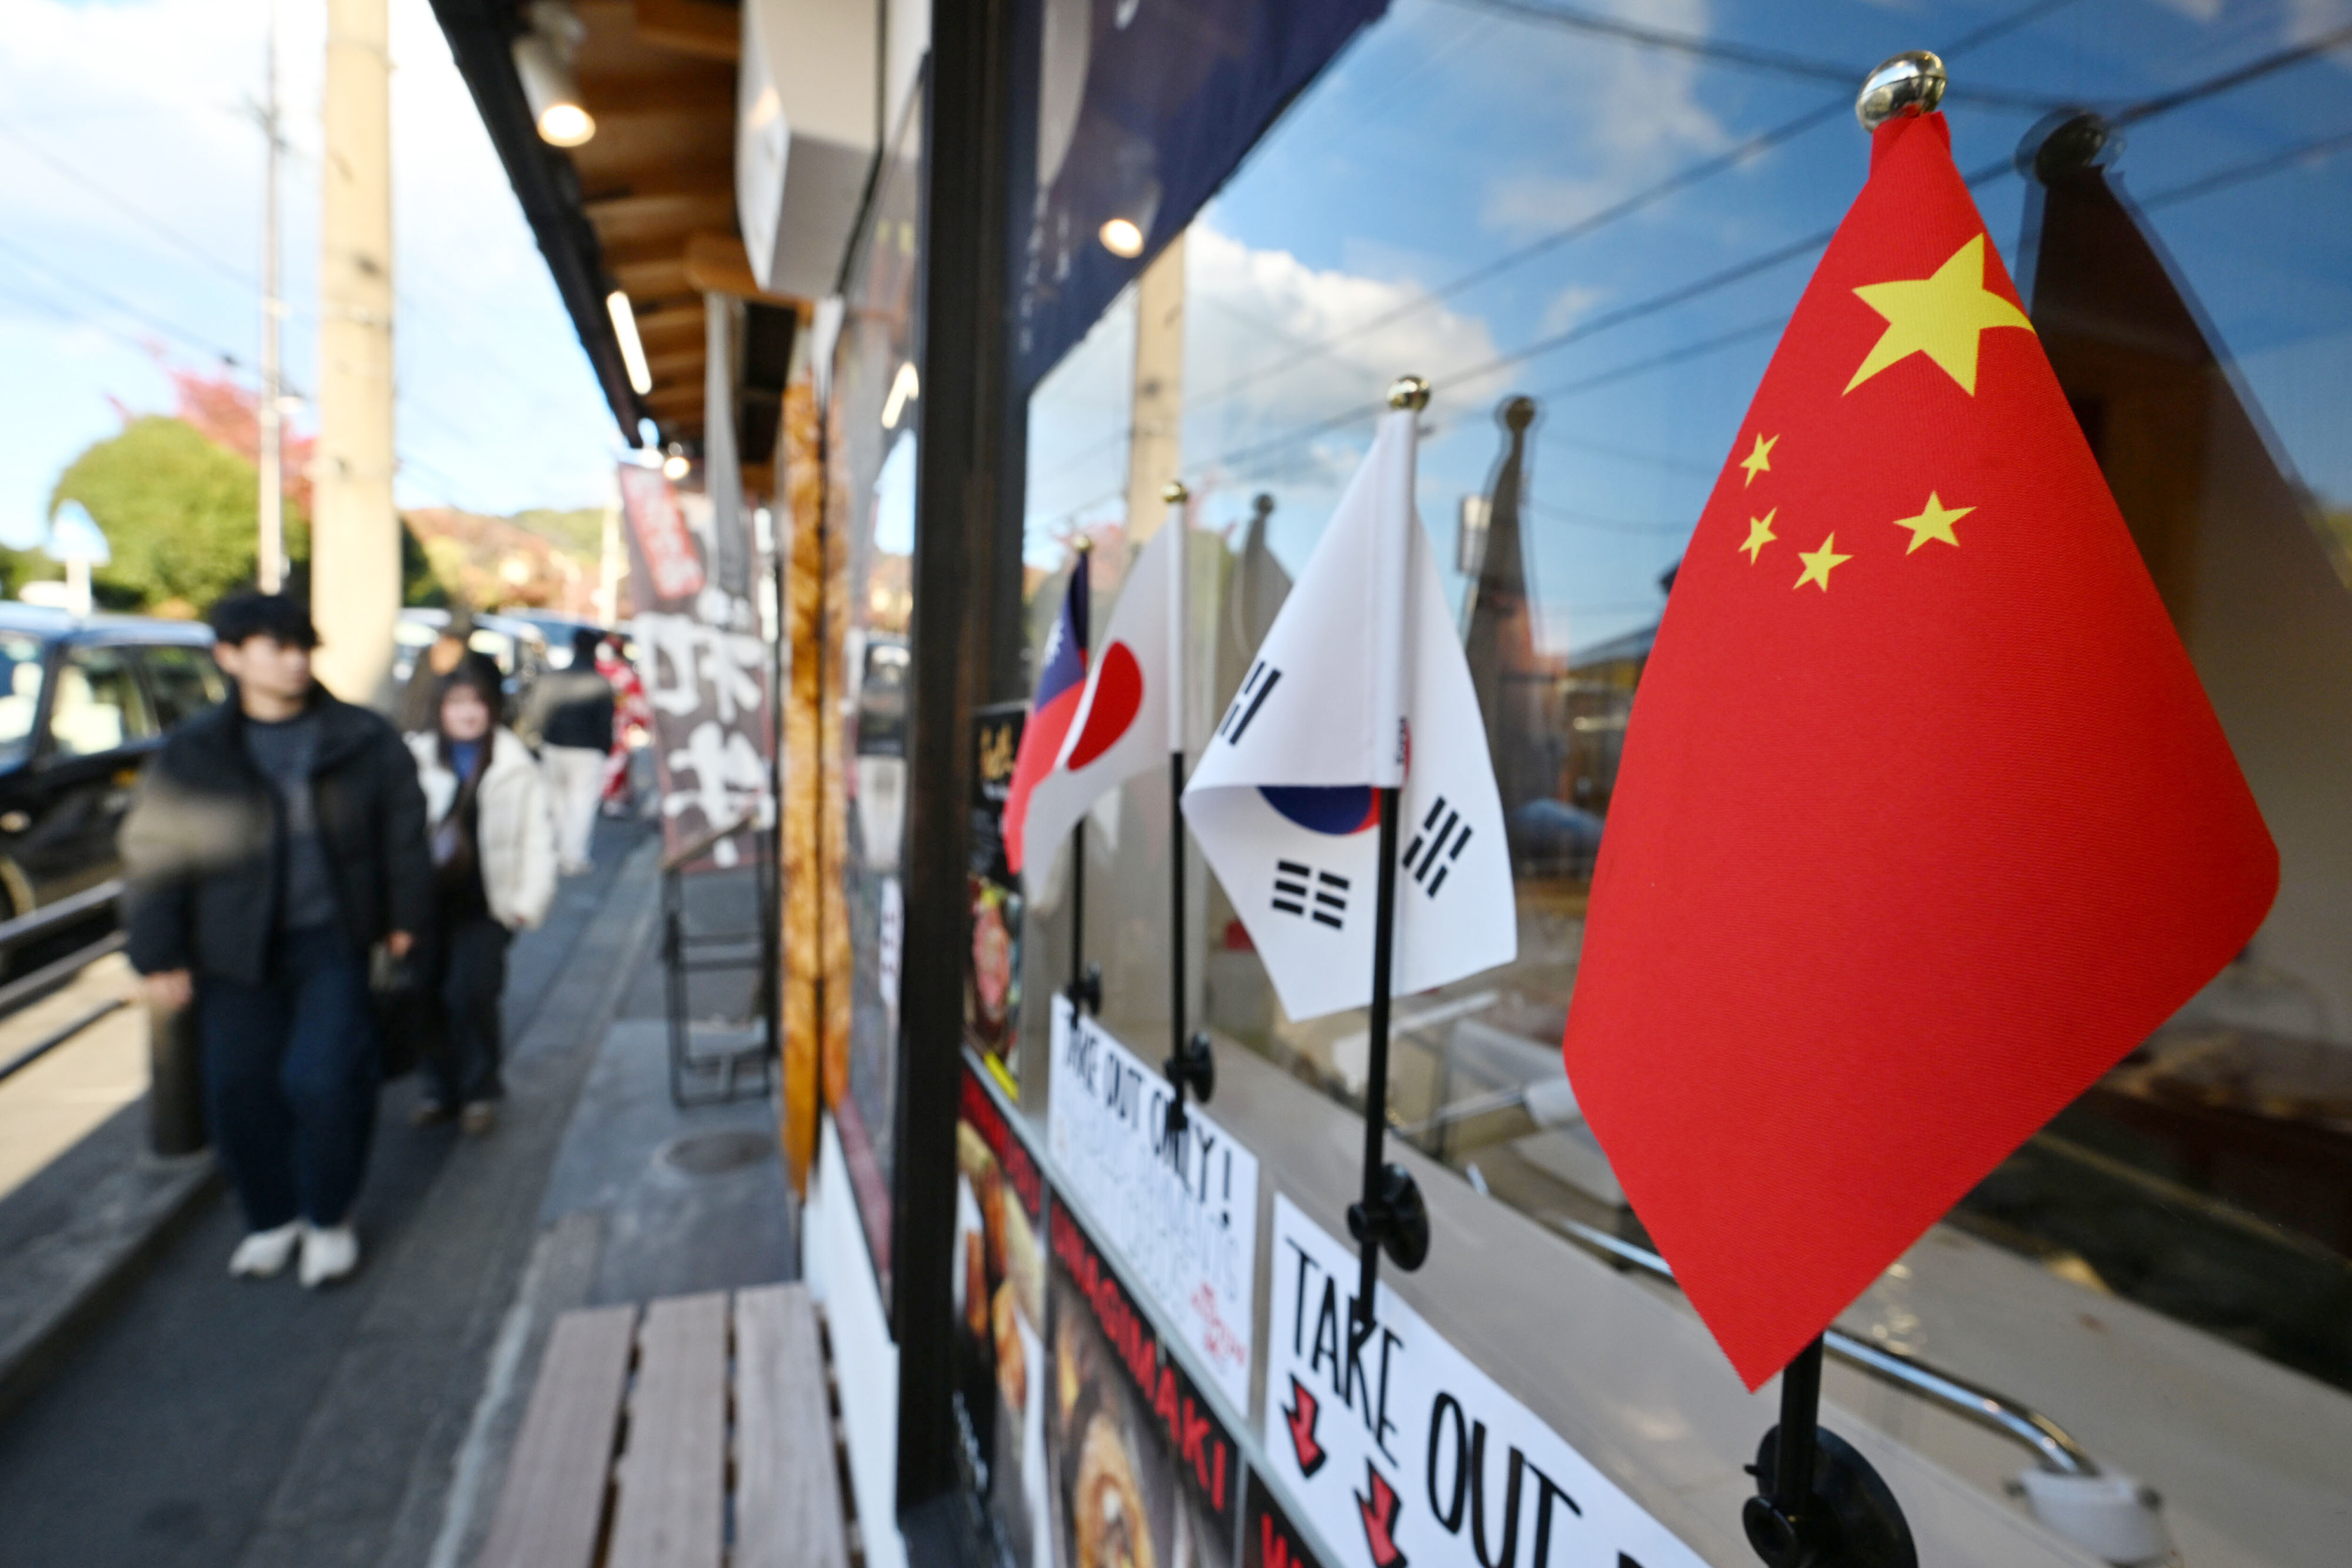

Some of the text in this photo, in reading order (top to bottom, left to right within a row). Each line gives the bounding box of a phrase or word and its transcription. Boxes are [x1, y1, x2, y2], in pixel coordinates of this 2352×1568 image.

[1104, 1052, 1143, 1130] OUT
[1285, 1235, 1403, 1468] TAKE
[1427, 1391, 1582, 1568] OUT
